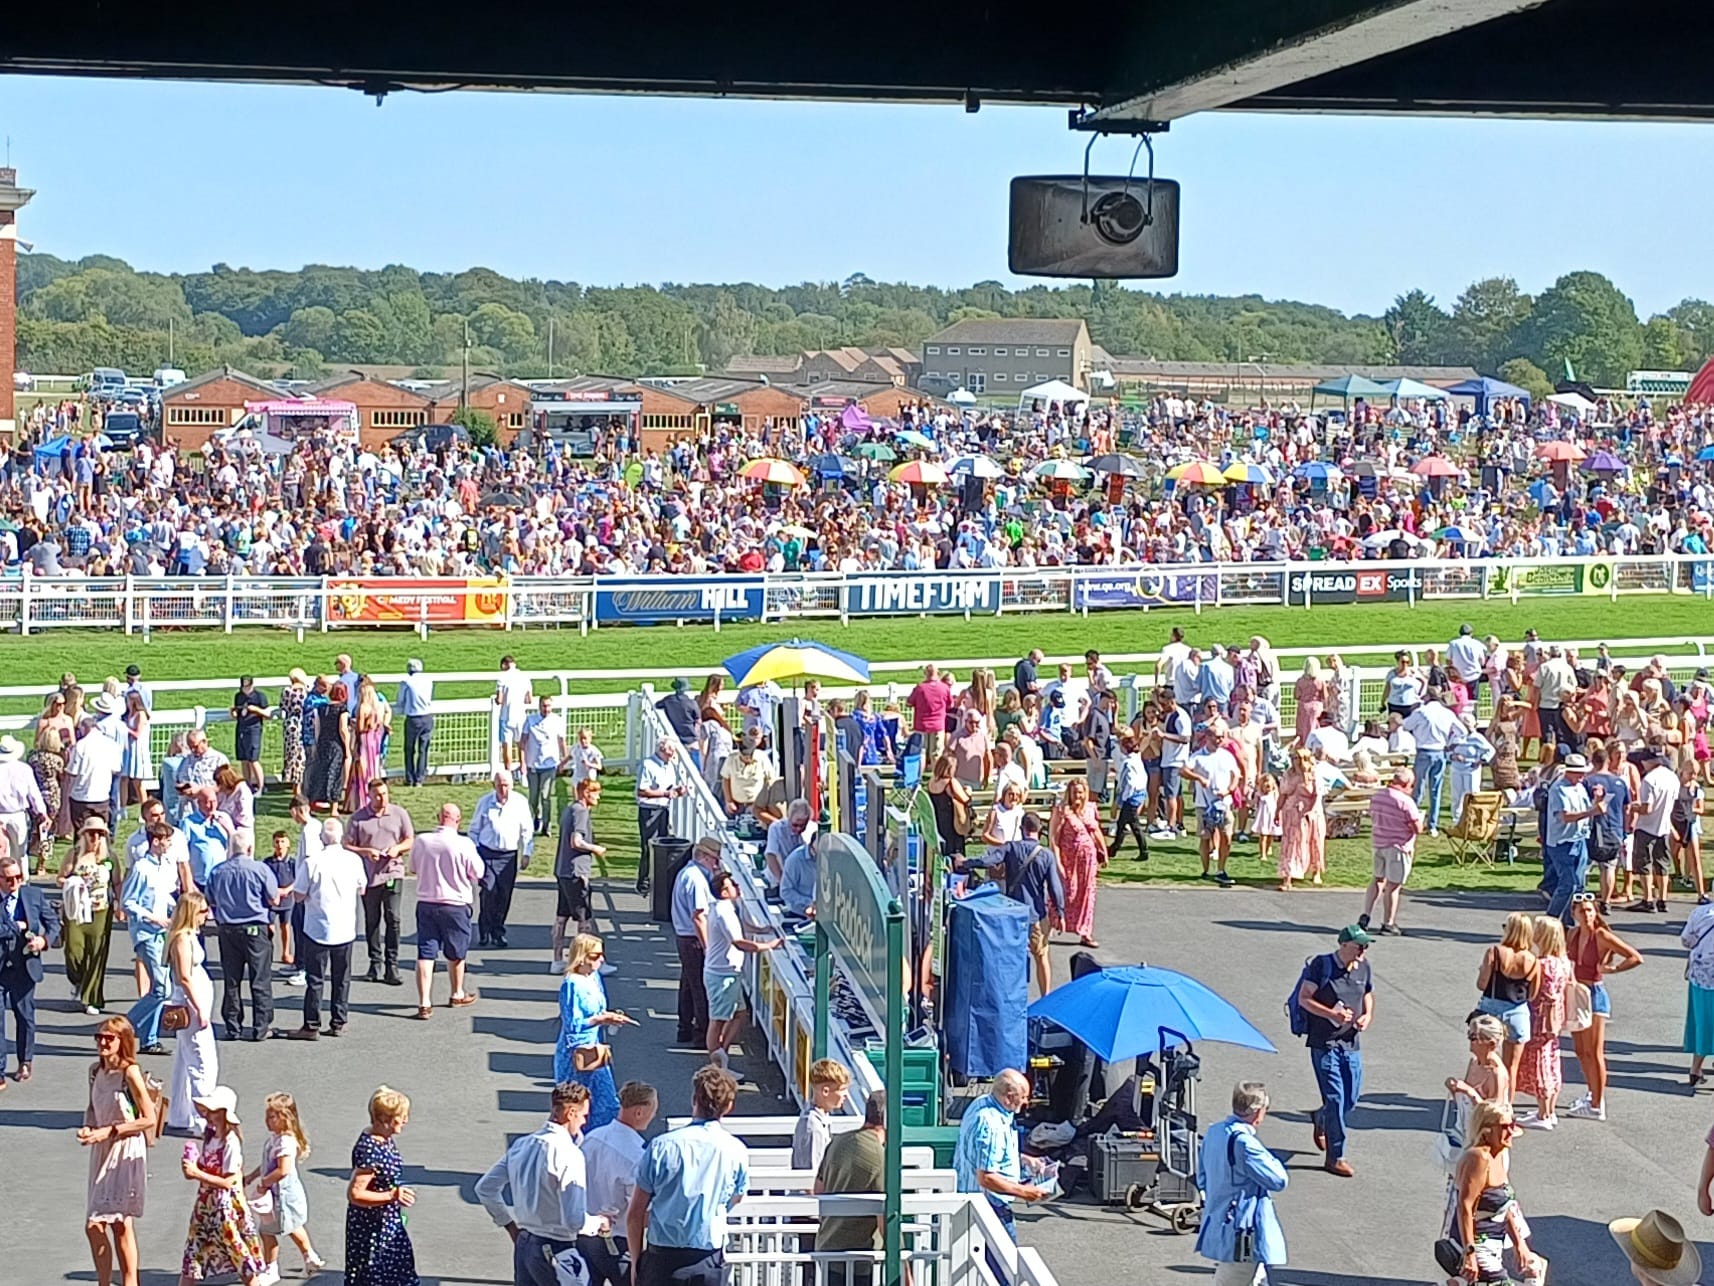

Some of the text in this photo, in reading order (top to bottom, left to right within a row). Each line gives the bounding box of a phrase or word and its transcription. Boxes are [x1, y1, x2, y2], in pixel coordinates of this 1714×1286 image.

[857, 577, 990, 609] TIMEFORM
[1359, 577, 1383, 591] EX
[612, 587, 749, 612] William HILL
[833, 871, 875, 973] Paddock
